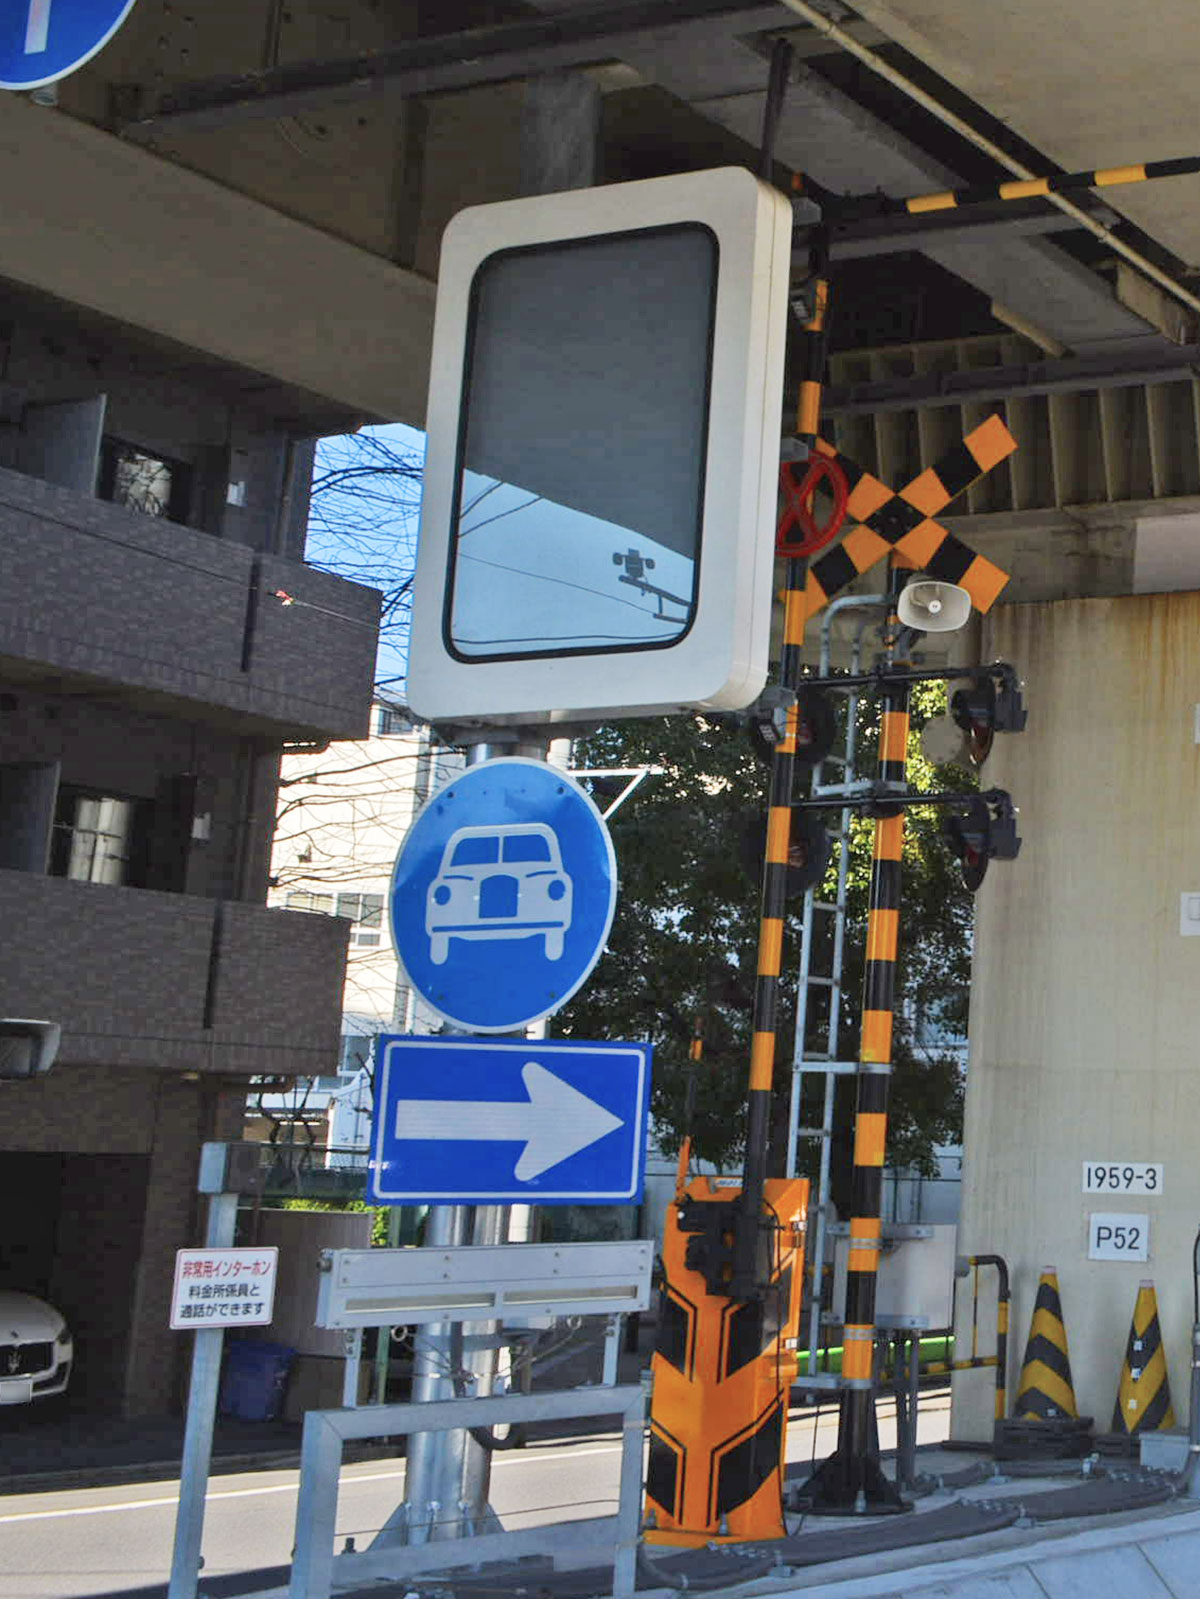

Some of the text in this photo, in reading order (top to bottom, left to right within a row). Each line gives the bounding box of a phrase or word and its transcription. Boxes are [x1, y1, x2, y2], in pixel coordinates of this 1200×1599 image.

[1087, 1166, 1157, 1190] 1959-3
[1096, 1226, 1140, 1250] P52
[182, 1260, 272, 1279] 非常用インターホン
[188, 1283, 260, 1299] 料金所係員と
[180, 1302, 264, 1319] 通話ができます
